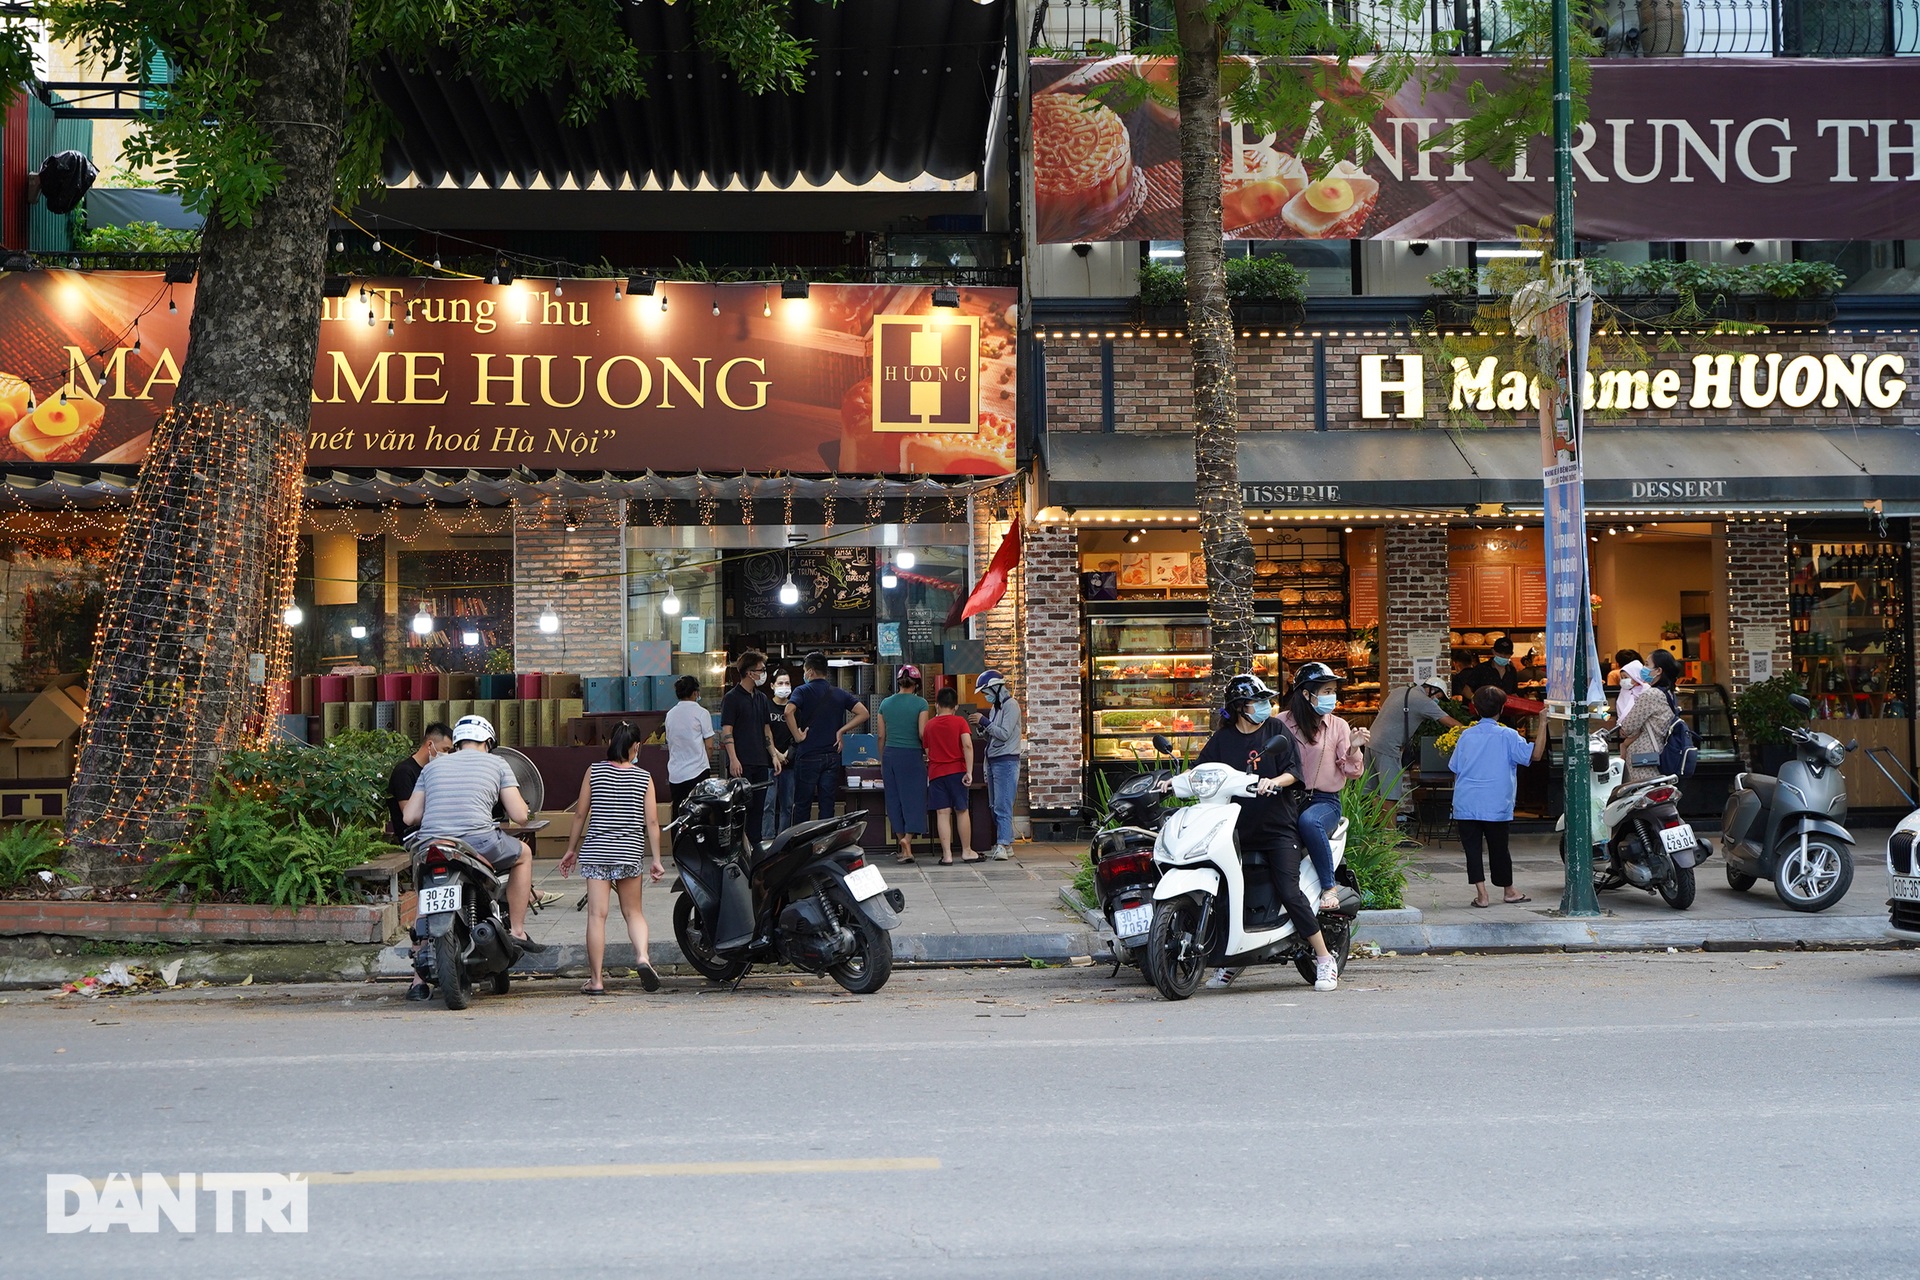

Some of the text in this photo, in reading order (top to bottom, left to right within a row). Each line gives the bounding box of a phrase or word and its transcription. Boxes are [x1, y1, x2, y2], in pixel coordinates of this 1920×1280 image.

[373, 287, 497, 334] Trung
[510, 290, 591, 326] Thu
[63, 346, 772, 411] MAME HUONG
[885, 366, 968, 382] HUONG
[1448, 353, 1907, 411] Maame HUONG
[309, 427, 355, 451] nét
[364, 429, 417, 452] văn
[428, 426, 480, 452] hoá
[490, 427, 534, 454] Hà
[1241, 485, 1341, 503] TISSERIE
[1631, 480, 1727, 499] DESSERT
[770, 712, 787, 722] DIO
[1667, 837, 1694, 850] 429.04
[426, 888, 455, 901] 30-Z6
[426, 899, 455, 912] 1528
